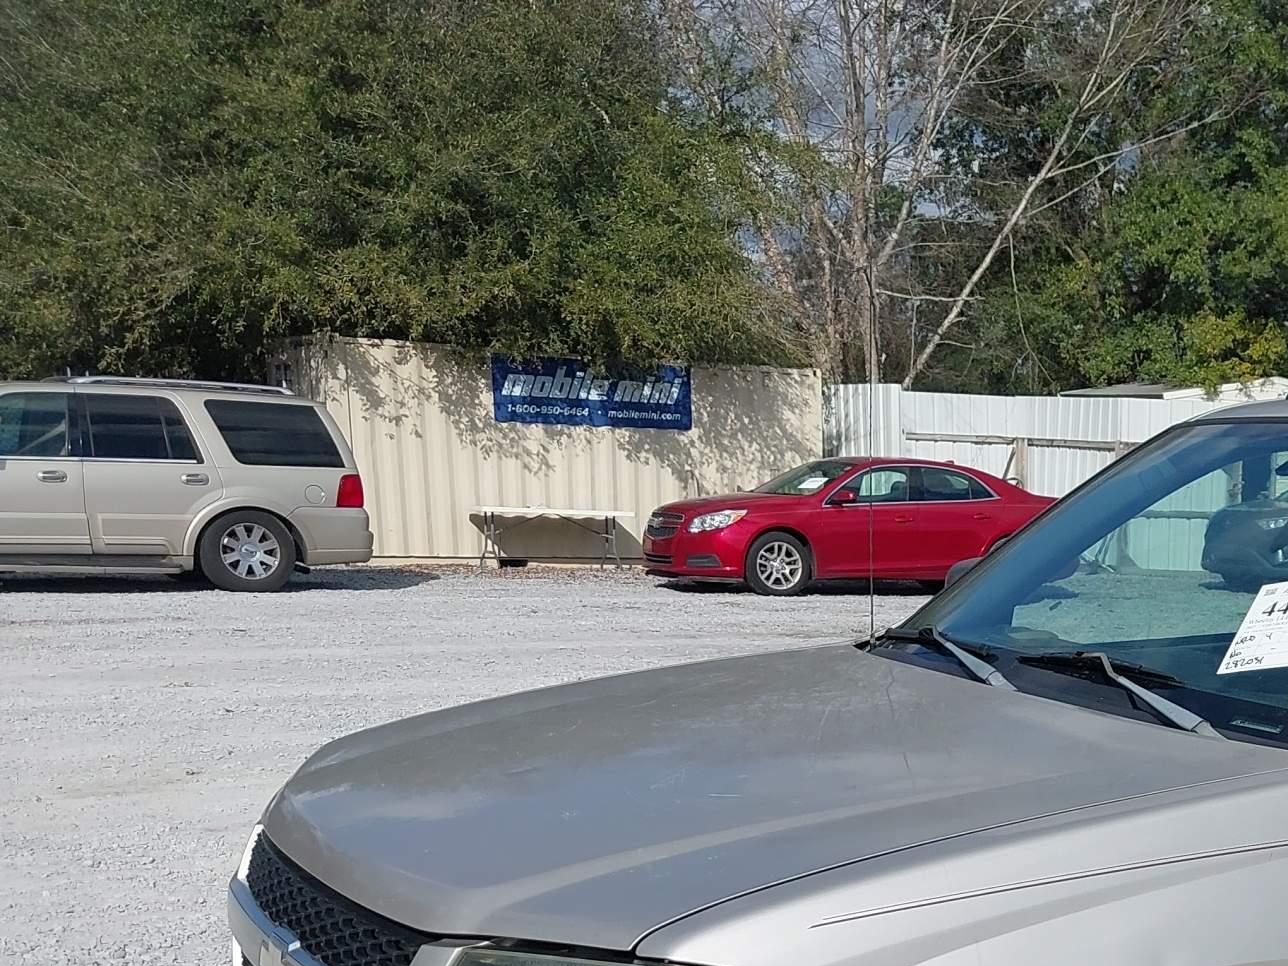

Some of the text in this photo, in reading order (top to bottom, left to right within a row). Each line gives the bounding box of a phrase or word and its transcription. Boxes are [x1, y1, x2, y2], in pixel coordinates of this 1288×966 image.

[501, 366, 683, 404] mobile mini
[607, 410, 681, 420] mobilemini.com
